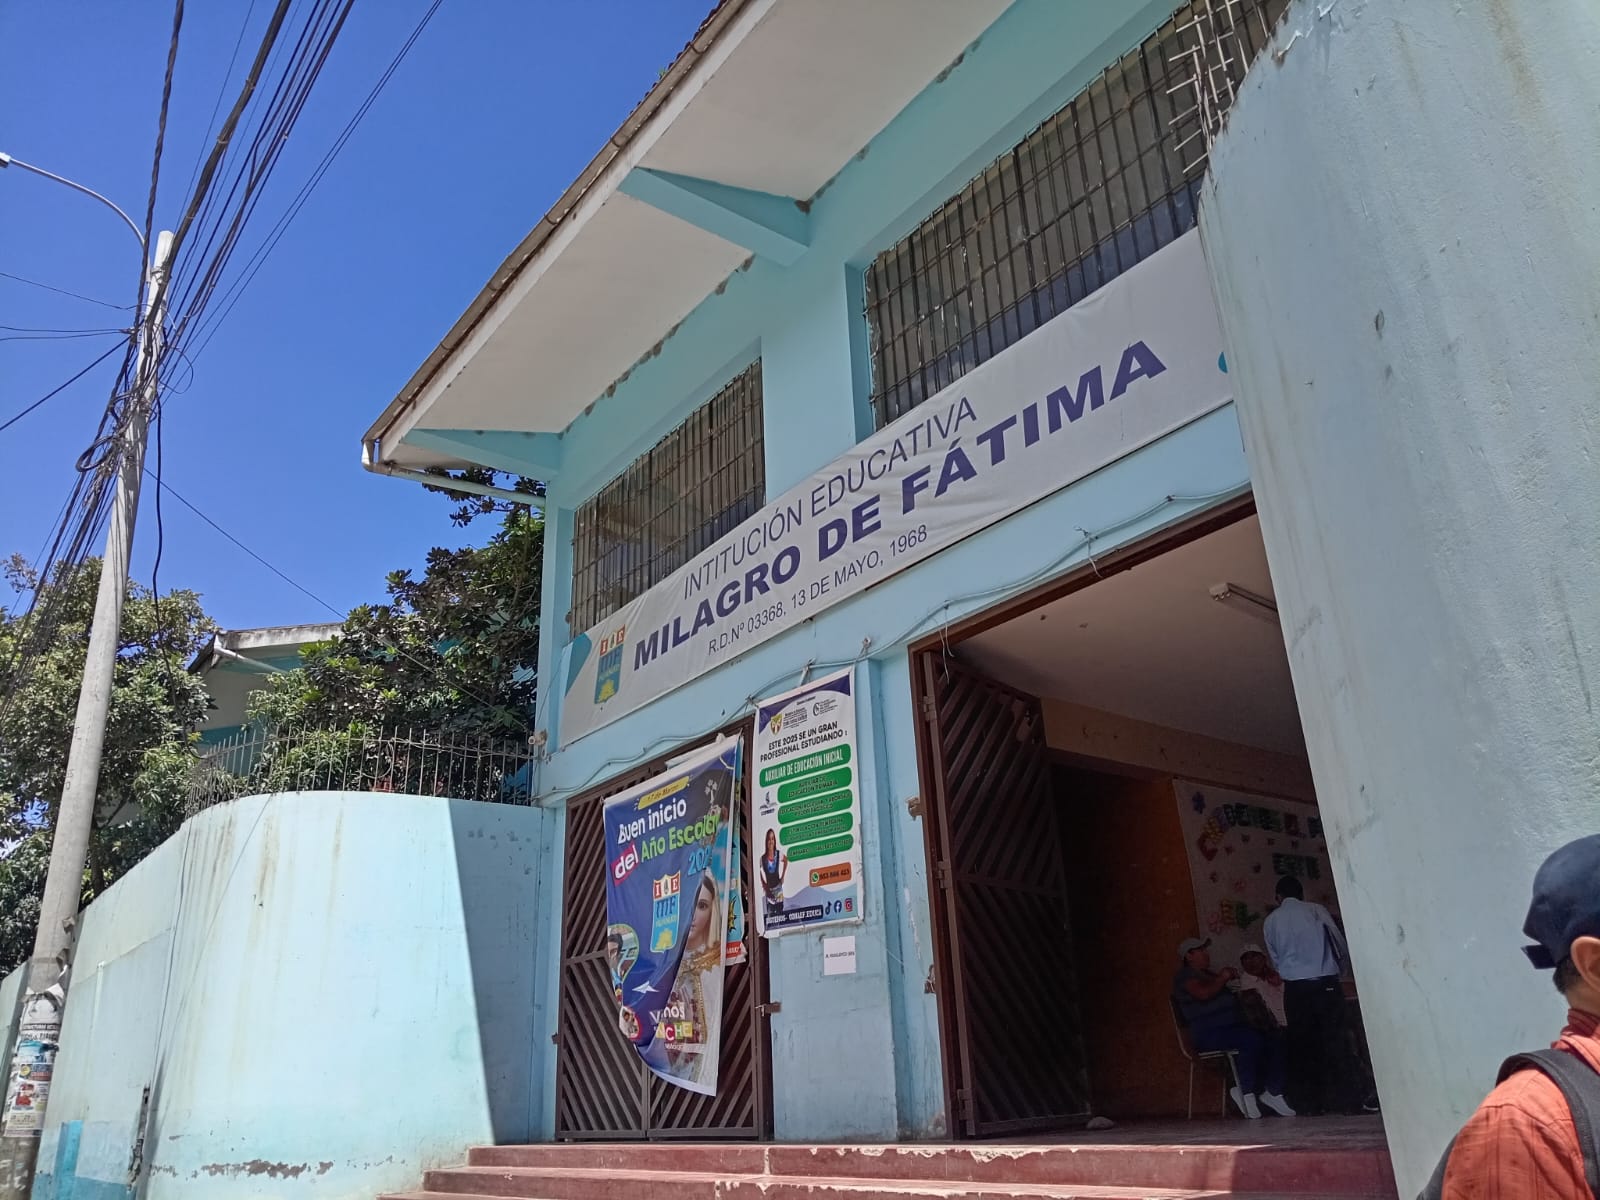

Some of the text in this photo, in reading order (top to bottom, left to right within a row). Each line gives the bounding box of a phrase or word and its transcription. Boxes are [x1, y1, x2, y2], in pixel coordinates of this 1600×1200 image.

[633, 340, 1167, 672] MILAGRO DE FÁTIMA
[684, 396, 977, 600] INTITUCIÓN EDUCATIVA
[791, 590, 806, 609] 13
[809, 575, 830, 600] DE
[834, 550, 884, 587] MAYO,
[889, 524, 928, 557] 1968
[760, 743, 800, 762] PROFESIONAL
[801, 729, 844, 749] ESTUDIANDO
[768, 721, 838, 751] ESTE 2025 SE UN GRAN
[786, 763, 794, 776] DE
[823, 748, 844, 766] INICIAL
[614, 813, 720, 879] del Año Escolar
[618, 797, 687, 845] Buen inicio
